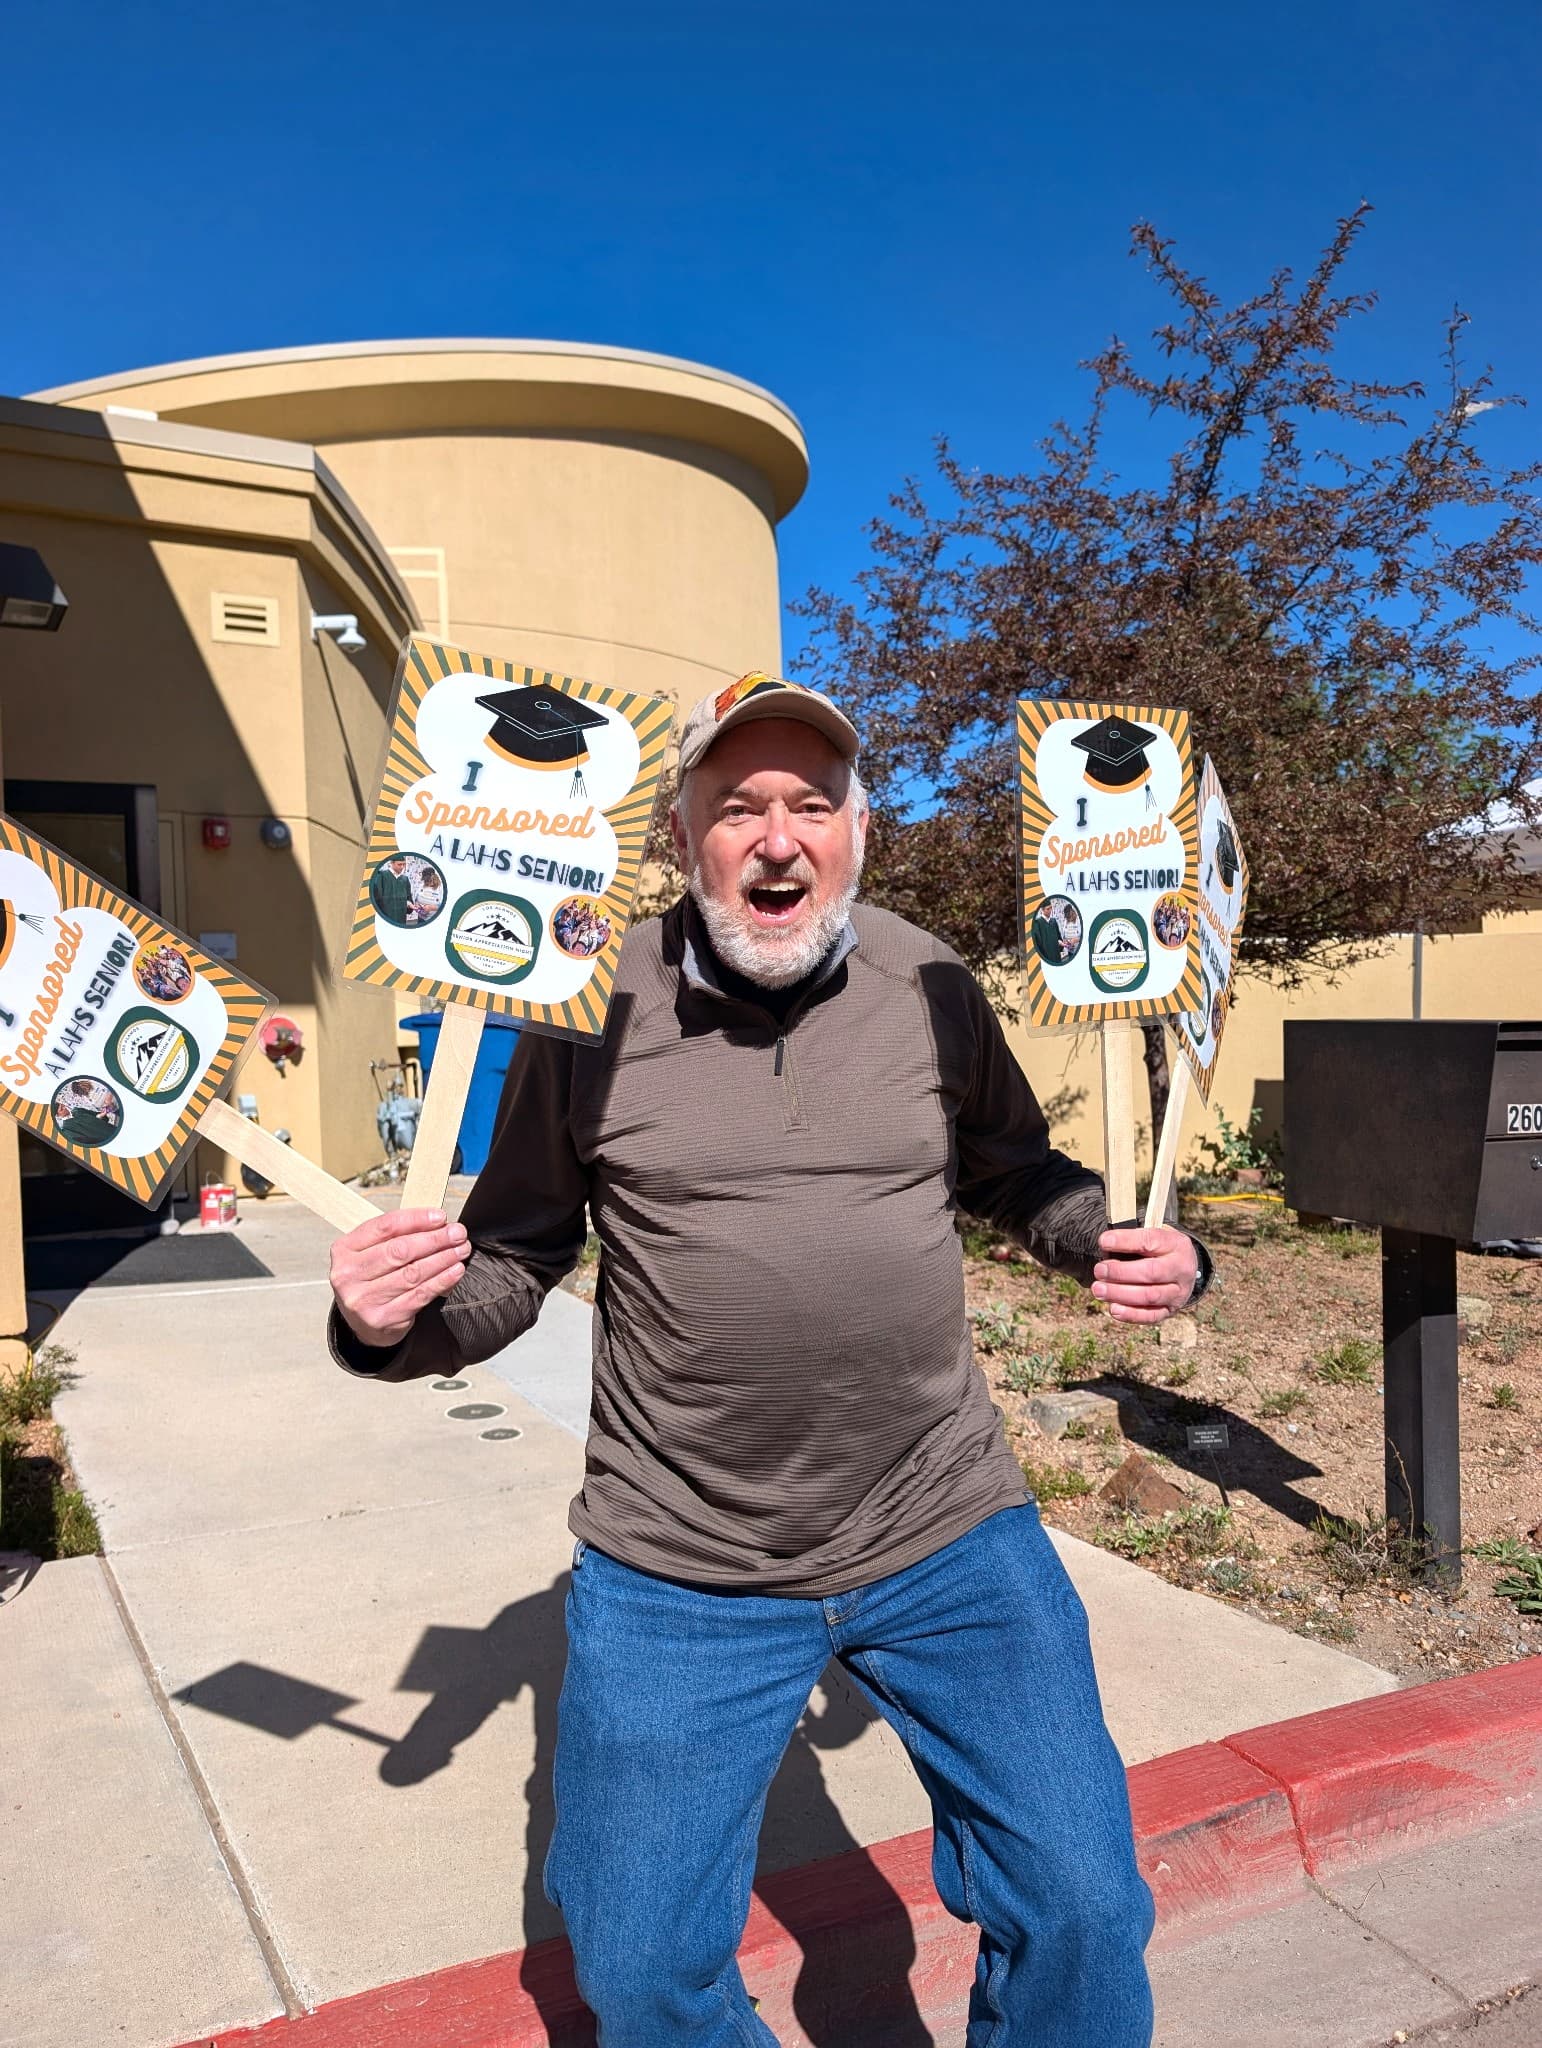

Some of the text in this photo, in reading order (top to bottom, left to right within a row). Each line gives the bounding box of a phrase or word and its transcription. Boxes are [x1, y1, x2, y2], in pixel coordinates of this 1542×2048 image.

[462, 761, 484, 791] I
[406, 791, 596, 839] Sponsored
[1076, 797, 1088, 827] I
[430, 834, 605, 893] A LAHS SENIOR!
[1044, 813, 1167, 875] Sponsored
[1065, 868, 1179, 892] A LAHS SENIOR!
[1, 915, 83, 1087] Sponsored
[44, 932, 136, 1079] A LAHS SENIOR!
[1509, 1105, 1542, 1132] 260
